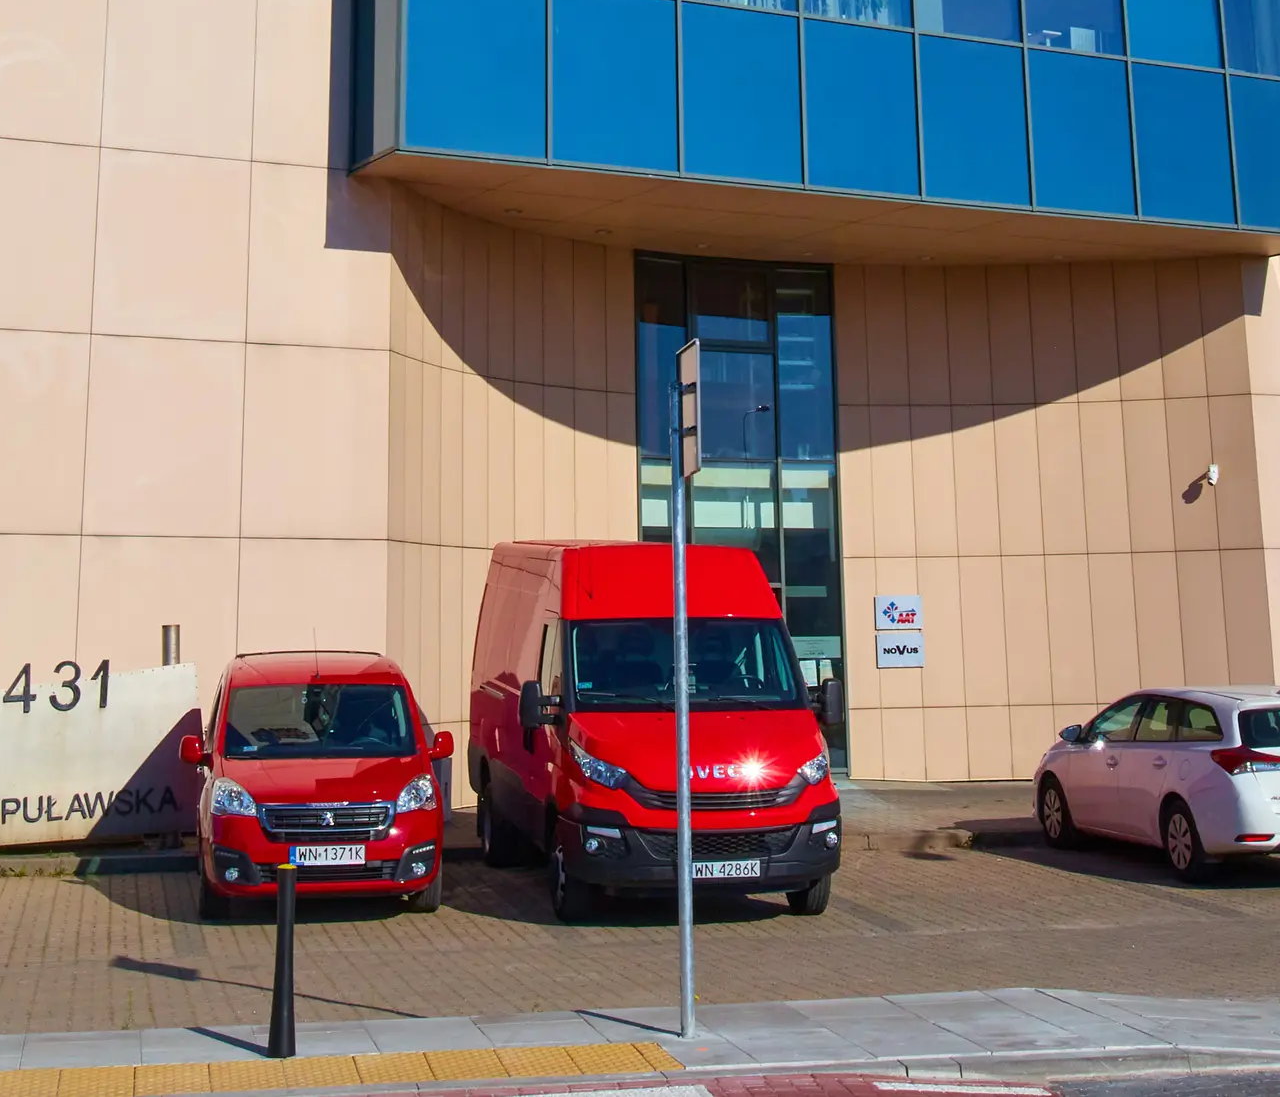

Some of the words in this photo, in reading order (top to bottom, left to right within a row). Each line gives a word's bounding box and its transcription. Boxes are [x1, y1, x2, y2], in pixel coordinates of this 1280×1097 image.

[896, 613, 917, 624] AAT
[3, 659, 109, 713] 431
[1, 786, 179, 824] PUŁAWSKA
